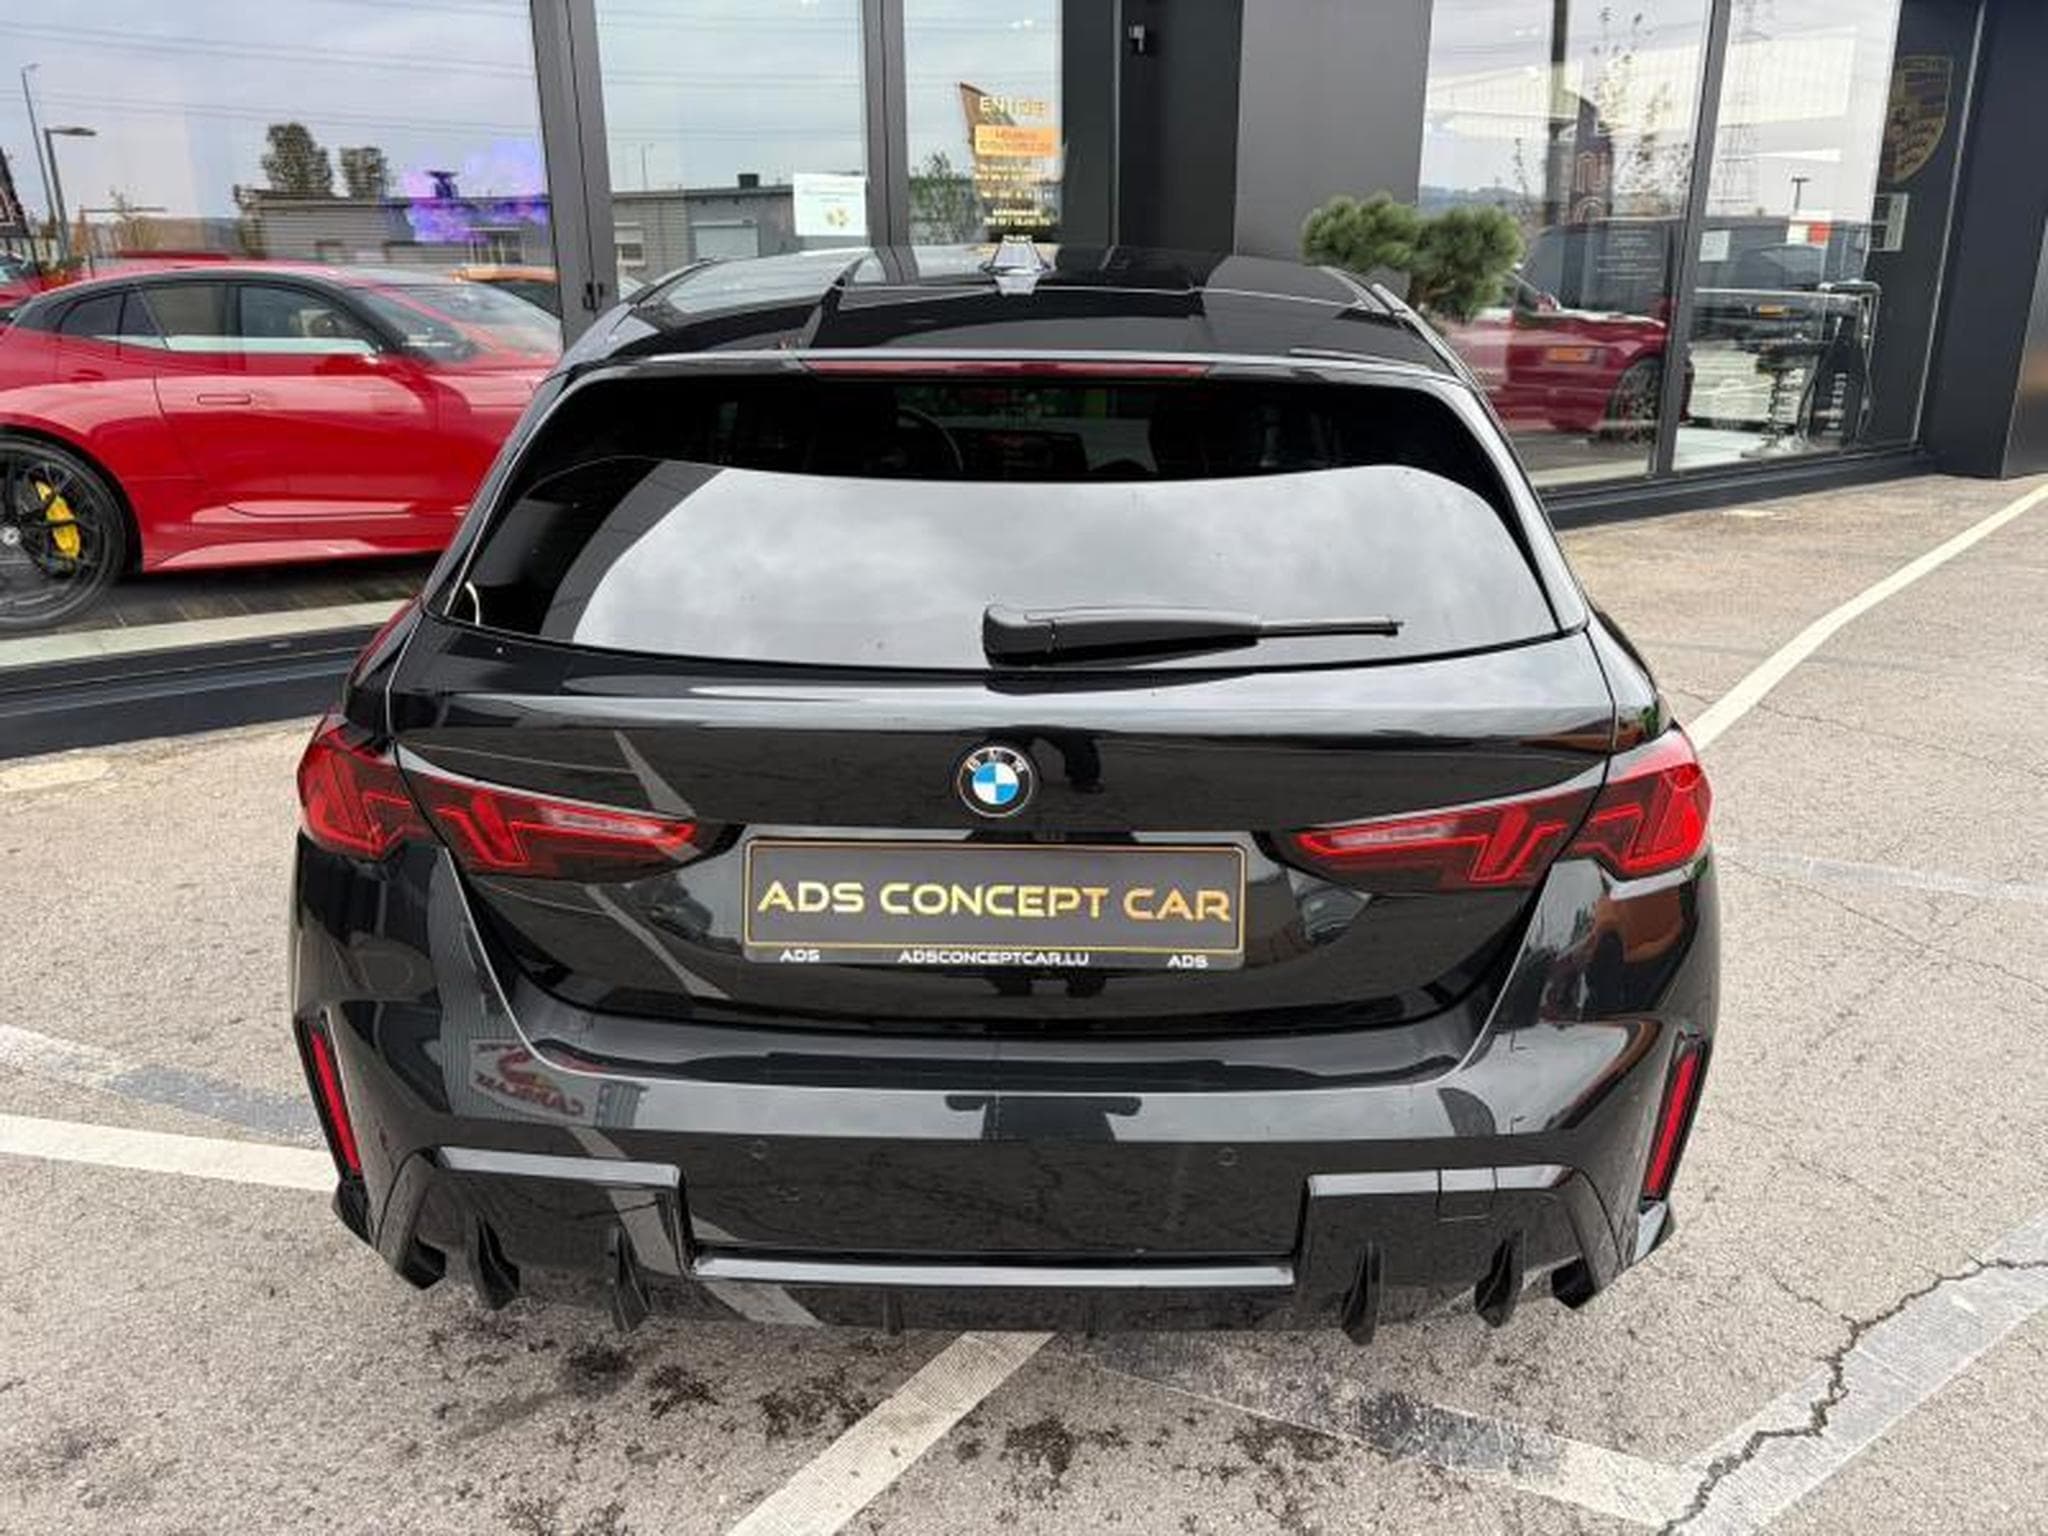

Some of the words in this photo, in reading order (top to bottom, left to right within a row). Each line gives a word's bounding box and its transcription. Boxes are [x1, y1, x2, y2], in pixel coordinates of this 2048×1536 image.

[757, 880, 865, 912] ADS
[879, 882, 1110, 918] CONCEPT
[1123, 887, 1231, 922] CAR
[780, 949, 820, 963] ADS
[898, 949, 1089, 966] ADSCONCEPTCAR.LU
[1167, 954, 1208, 968] ADS
